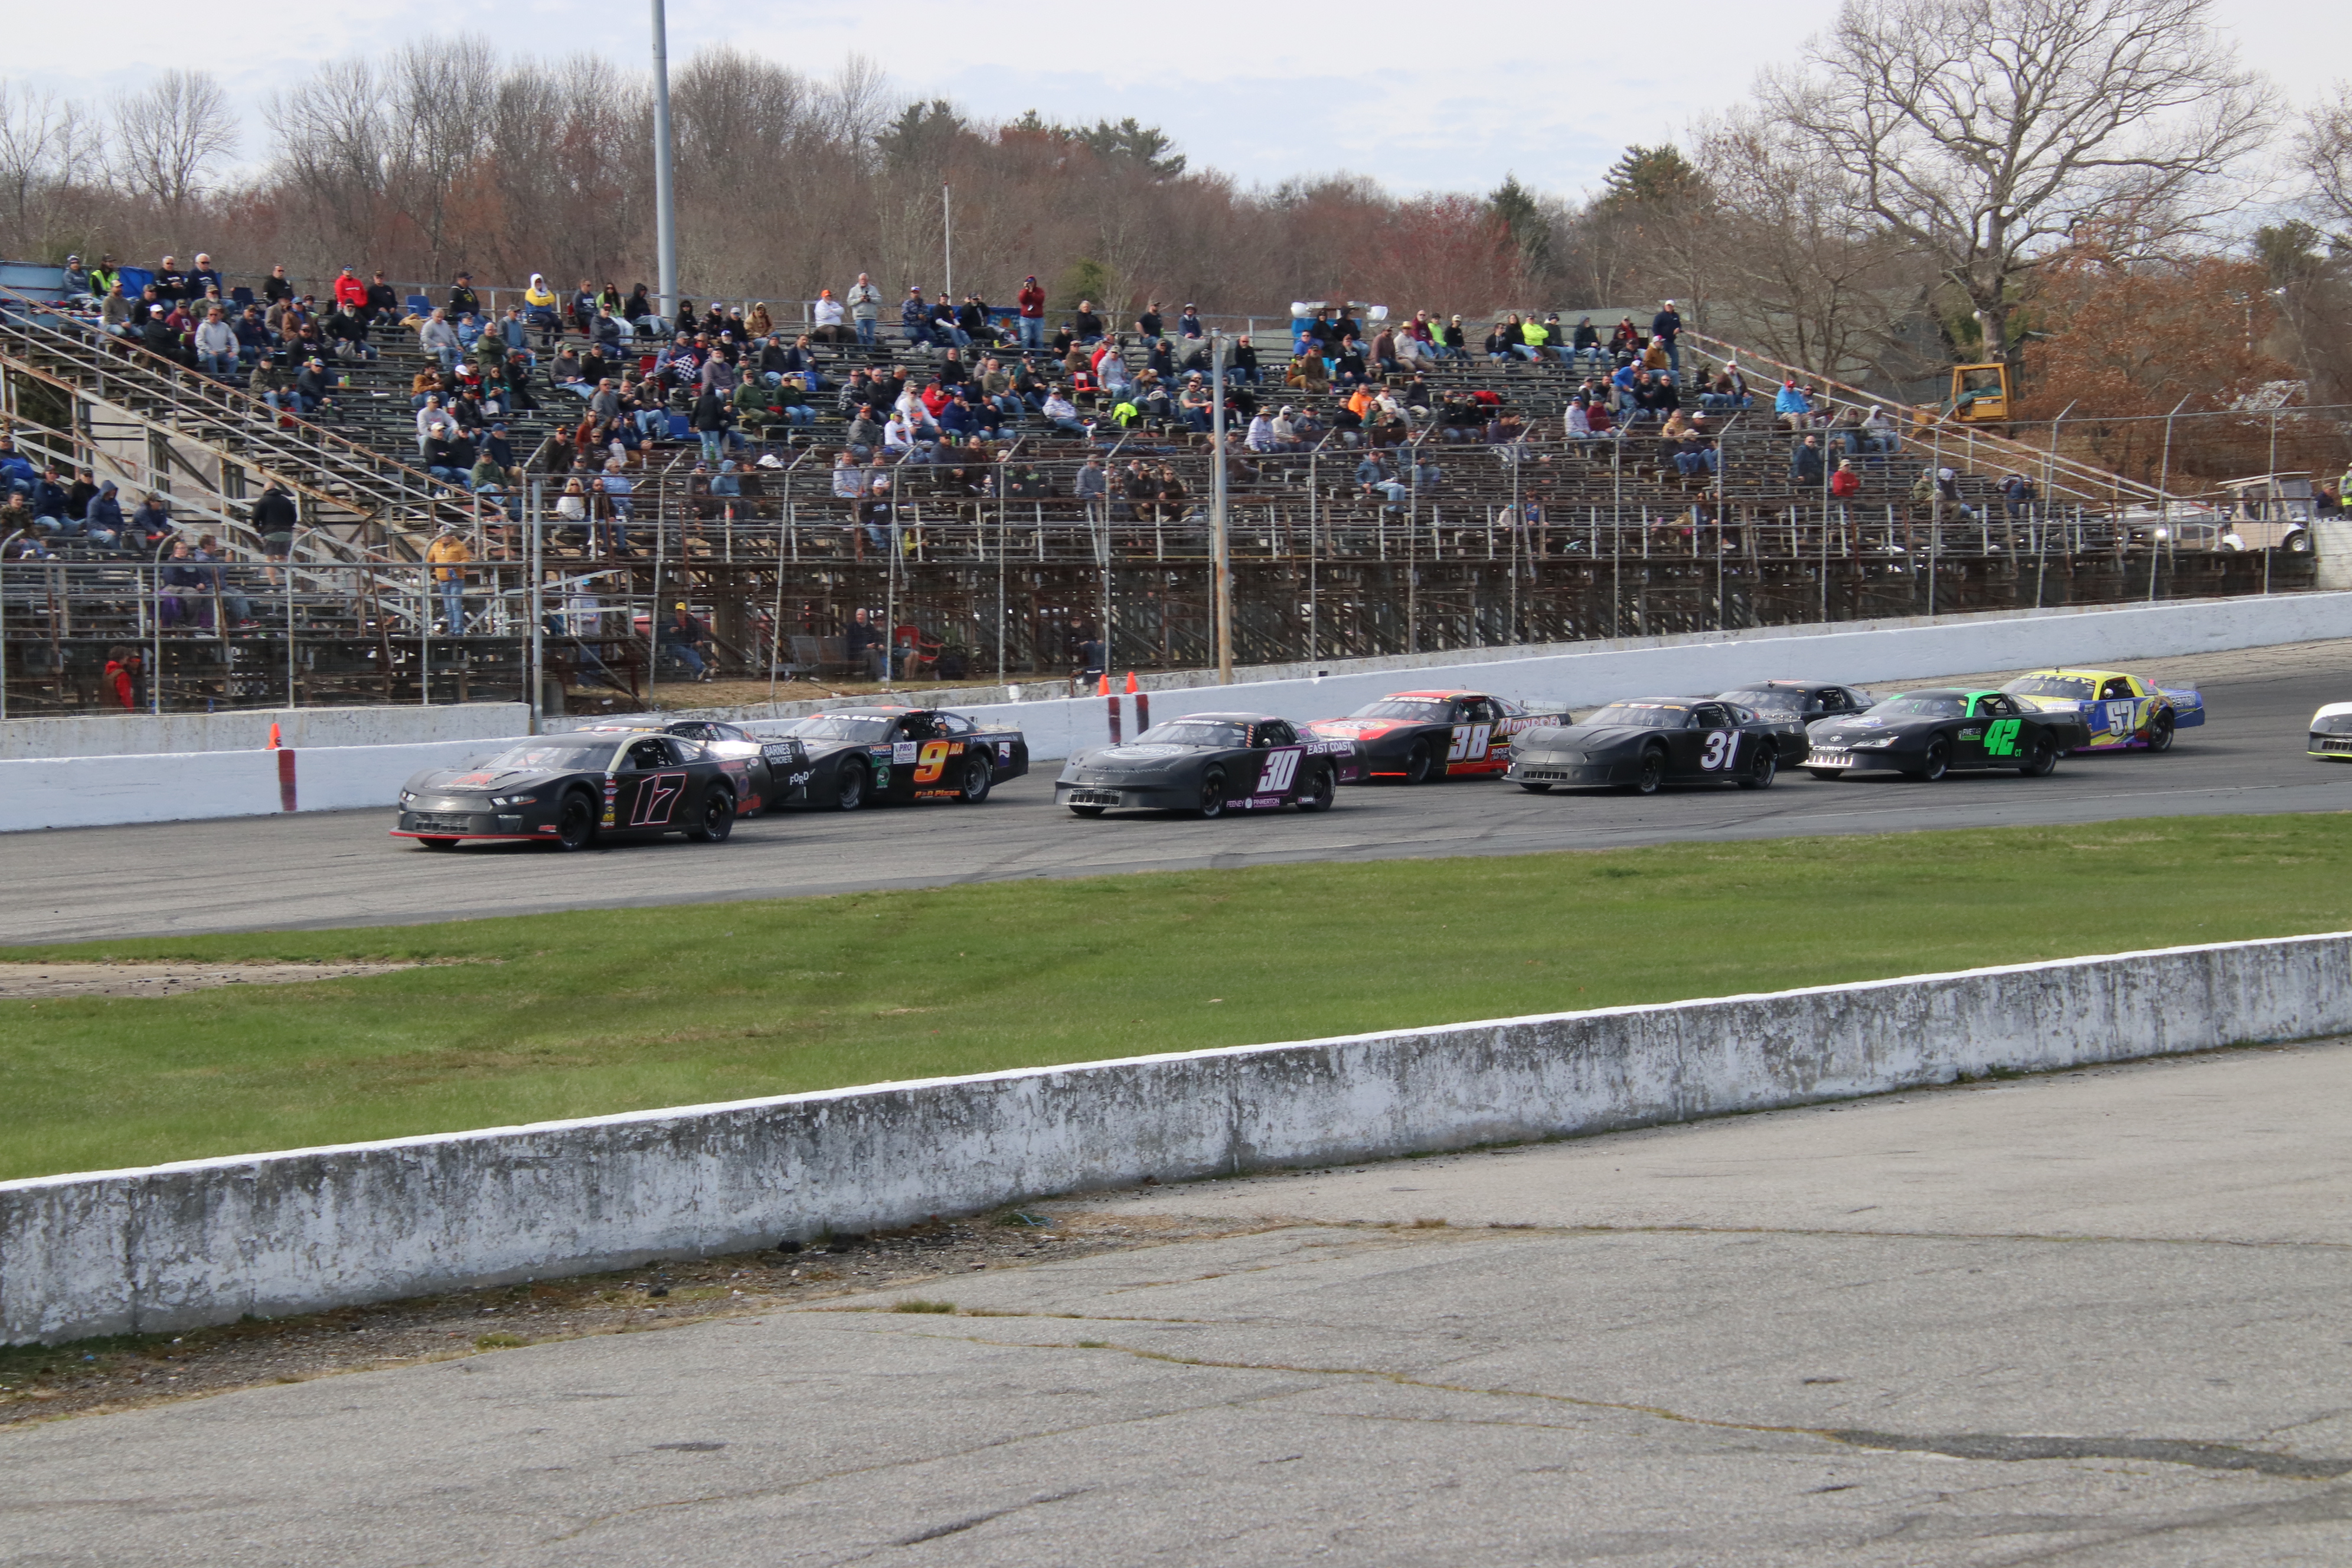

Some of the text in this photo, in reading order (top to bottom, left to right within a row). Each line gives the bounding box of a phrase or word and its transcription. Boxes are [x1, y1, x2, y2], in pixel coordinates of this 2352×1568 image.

[2018, 675, 2095, 684] PETTEY
[2106, 700, 2135, 737] 57
[763, 744, 790, 756] BARNES
[1306, 743, 1328, 755] EAST
[1329, 741, 1351, 752] COAST
[1445, 723, 1492, 765] 38
[1700, 729, 1741, 771] 31
[1984, 719, 2021, 755] 42
[770, 756, 793, 765] CONCRETE
[790, 772, 809, 785] FORD
[913, 740, 964, 783] 9 MA
[1256, 749, 1301, 792] 30
[629, 772, 688, 826] 17
